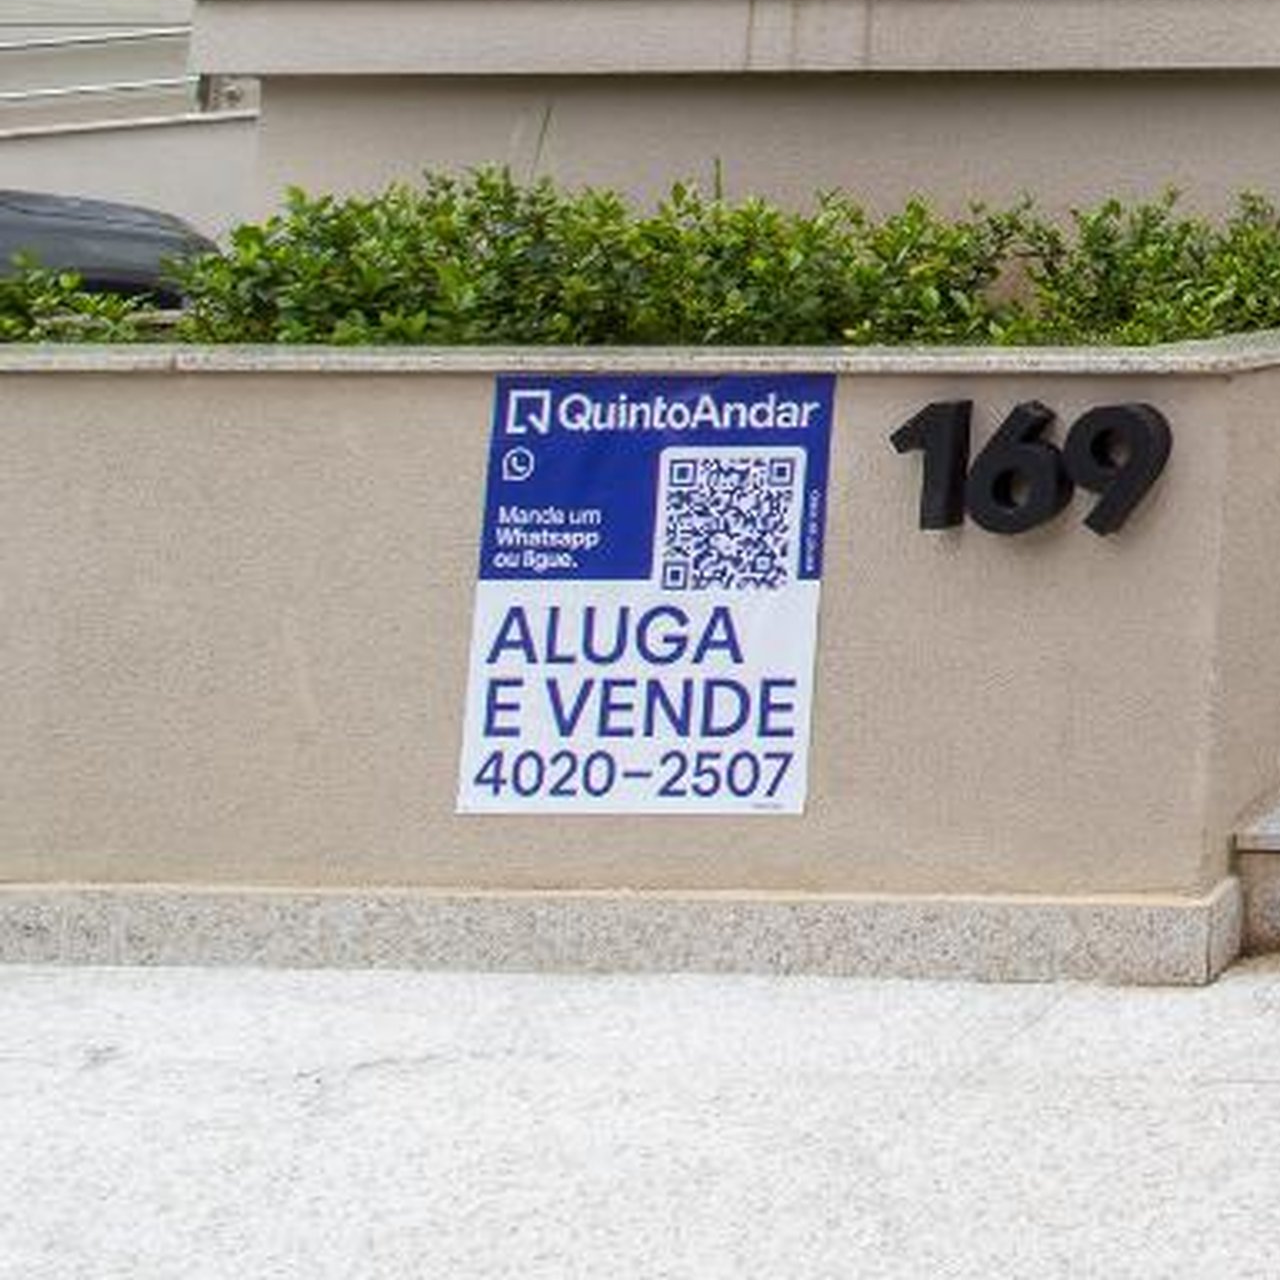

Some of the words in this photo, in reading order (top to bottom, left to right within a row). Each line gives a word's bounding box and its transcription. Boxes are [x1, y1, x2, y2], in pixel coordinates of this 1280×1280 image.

[558, 393, 821, 432] QuintoAndar
[890, 399, 1173, 537] 169
[499, 506, 564, 524] Mande
[569, 509, 601, 524] um
[492, 552, 520, 568] ou
[485, 606, 744, 666] ALUGA
[483, 678, 524, 738] E
[545, 678, 797, 738] VENDE
[474, 750, 793, 798] 4020-2507
